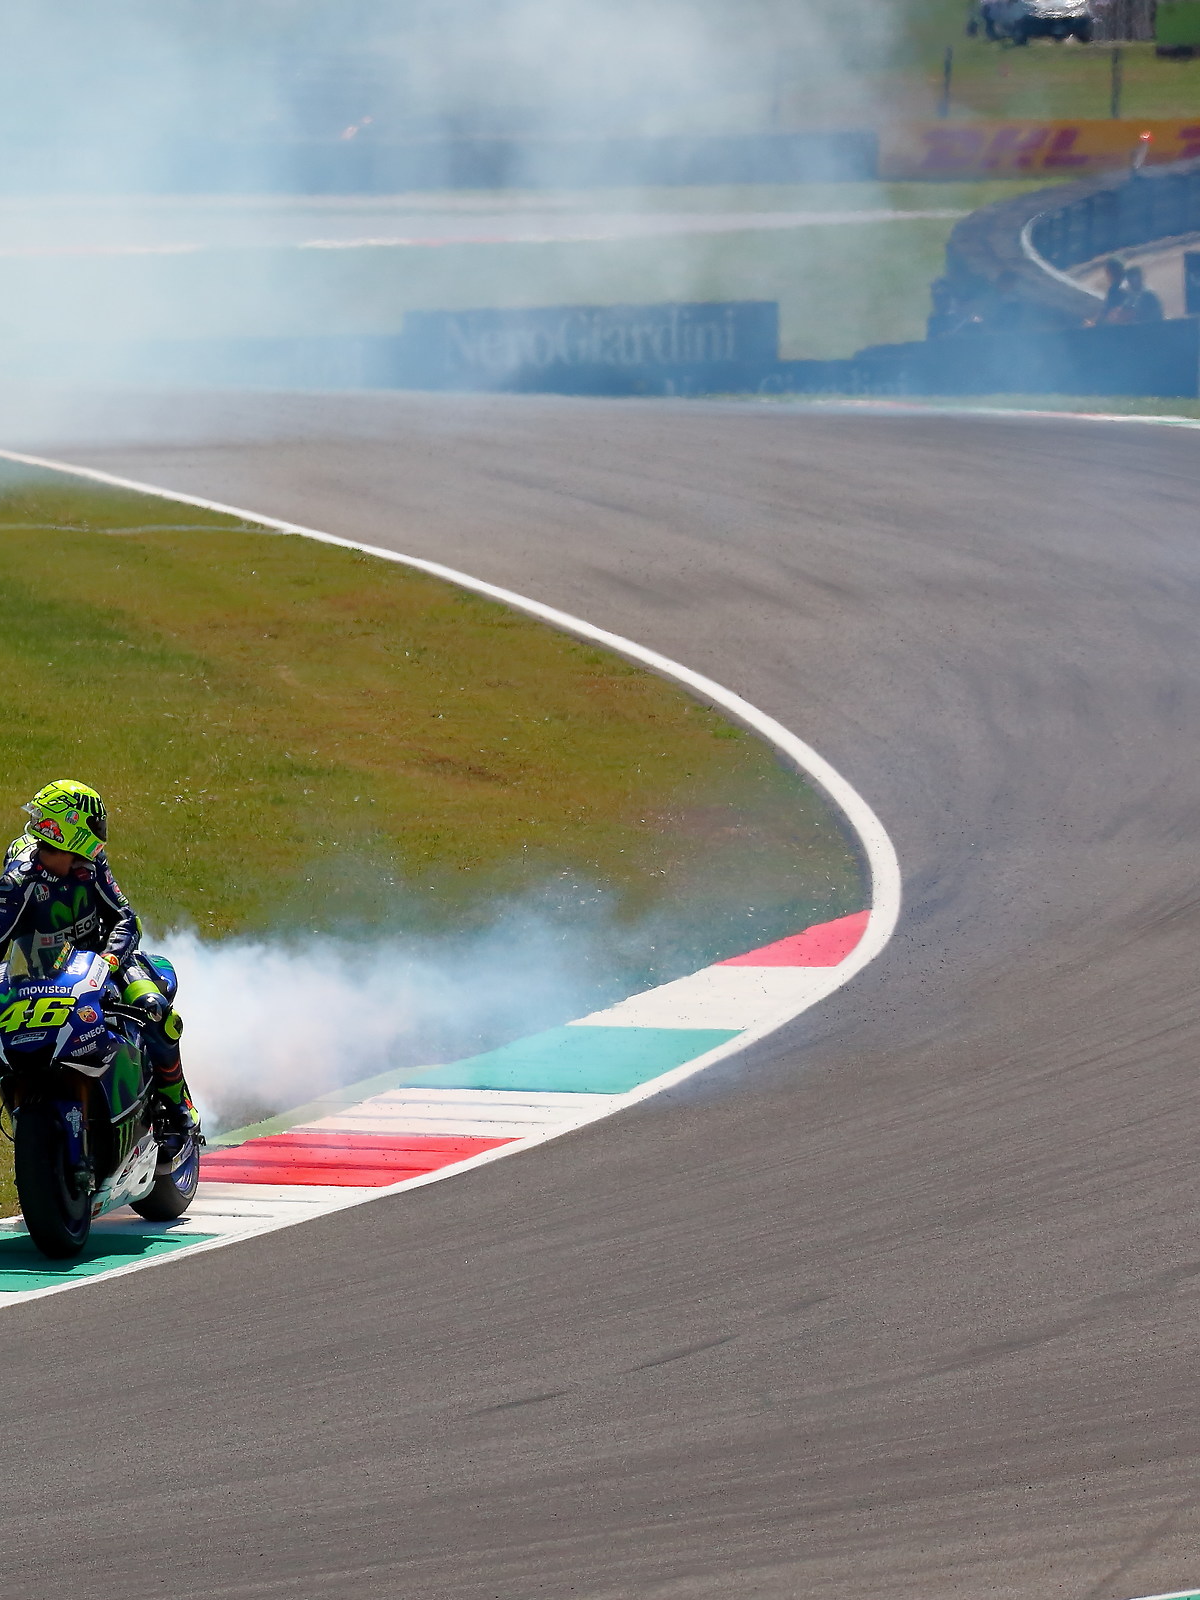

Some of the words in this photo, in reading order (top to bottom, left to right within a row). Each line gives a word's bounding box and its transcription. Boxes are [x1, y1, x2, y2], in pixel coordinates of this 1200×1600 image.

[443, 306, 736, 370] NeroGiardini
[19, 984, 73, 997] movistar
[79, 1024, 105, 1042] ENEOS
